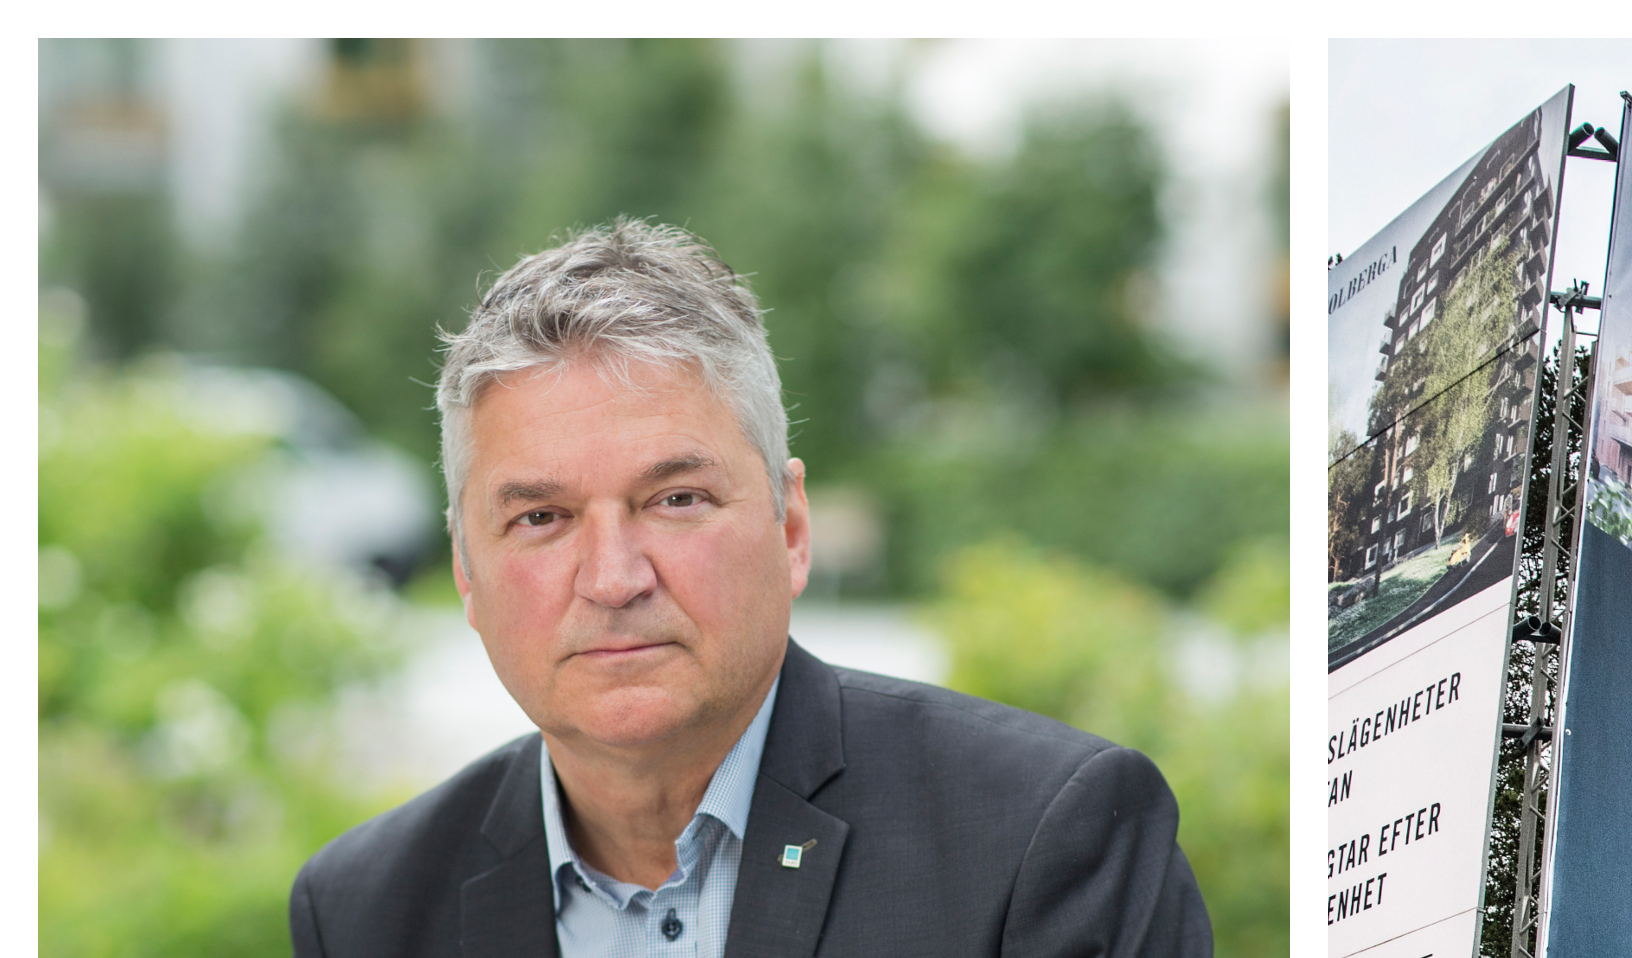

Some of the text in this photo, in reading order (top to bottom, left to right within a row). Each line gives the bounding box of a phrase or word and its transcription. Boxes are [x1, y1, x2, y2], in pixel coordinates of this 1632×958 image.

[1328, 245, 1397, 315] OLBERGA
[1328, 671, 1461, 765] SLÄGENHETER
[1328, 769, 1353, 808] AN
[1378, 802, 1441, 857] EFTER
[1328, 872, 1388, 926] ENHET
